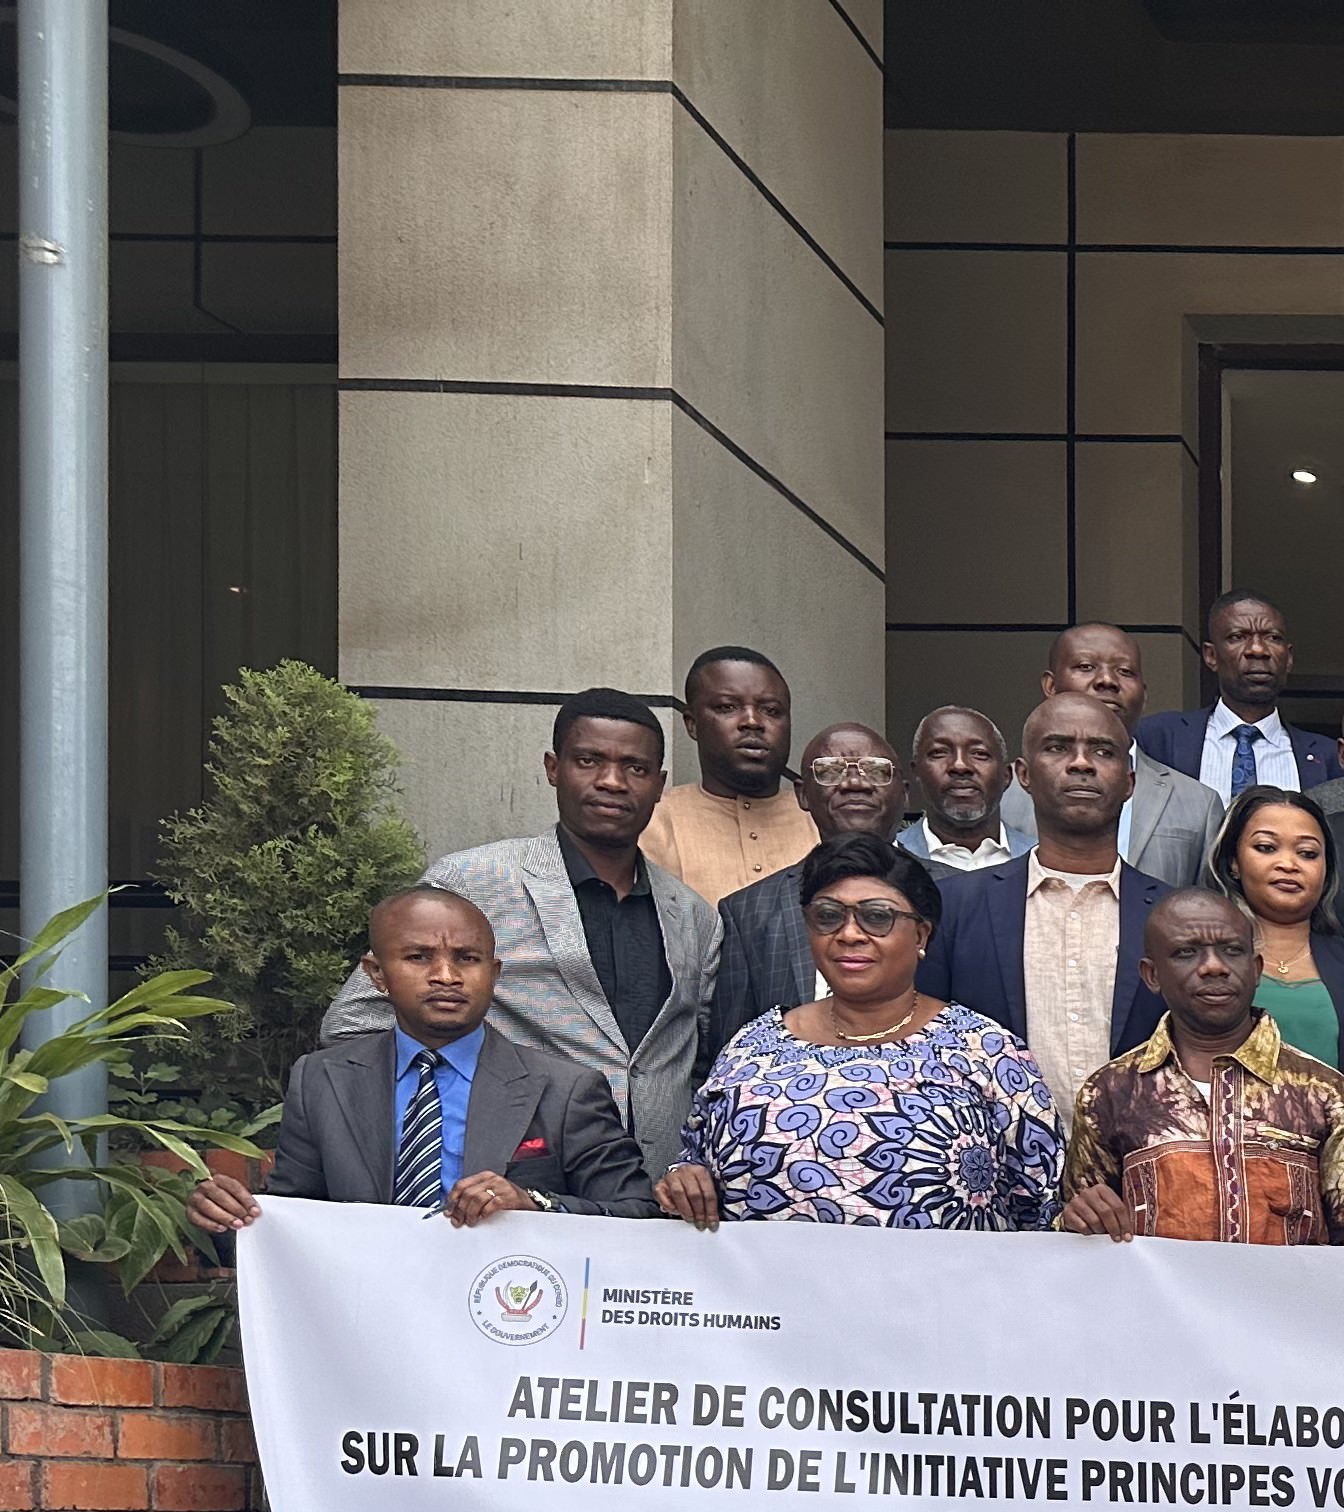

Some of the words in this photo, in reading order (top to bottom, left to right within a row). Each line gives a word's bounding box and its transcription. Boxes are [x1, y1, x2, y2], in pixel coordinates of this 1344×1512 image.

[602, 1287, 694, 1306] MINISTÈRE
[481, 1319, 493, 1330] LE
[601, 1309, 635, 1324] DES
[638, 1311, 700, 1327] DROITS
[703, 1314, 782, 1331] HUMAINS
[507, 1375, 679, 1426] ATELIER
[692, 1383, 746, 1428] DE
[758, 1386, 1052, 1440] CONSULTATION
[1065, 1397, 1176, 1444] POUR
[340, 1430, 419, 1477] SUR
[433, 1434, 483, 1479] LA
[498, 1437, 753, 1490] PROMOTION
[766, 1448, 823, 1492] DE
[833, 1451, 1069, 1501] L'INITIATIVE
[1081, 1459, 1295, 1507] PRINCIPES
